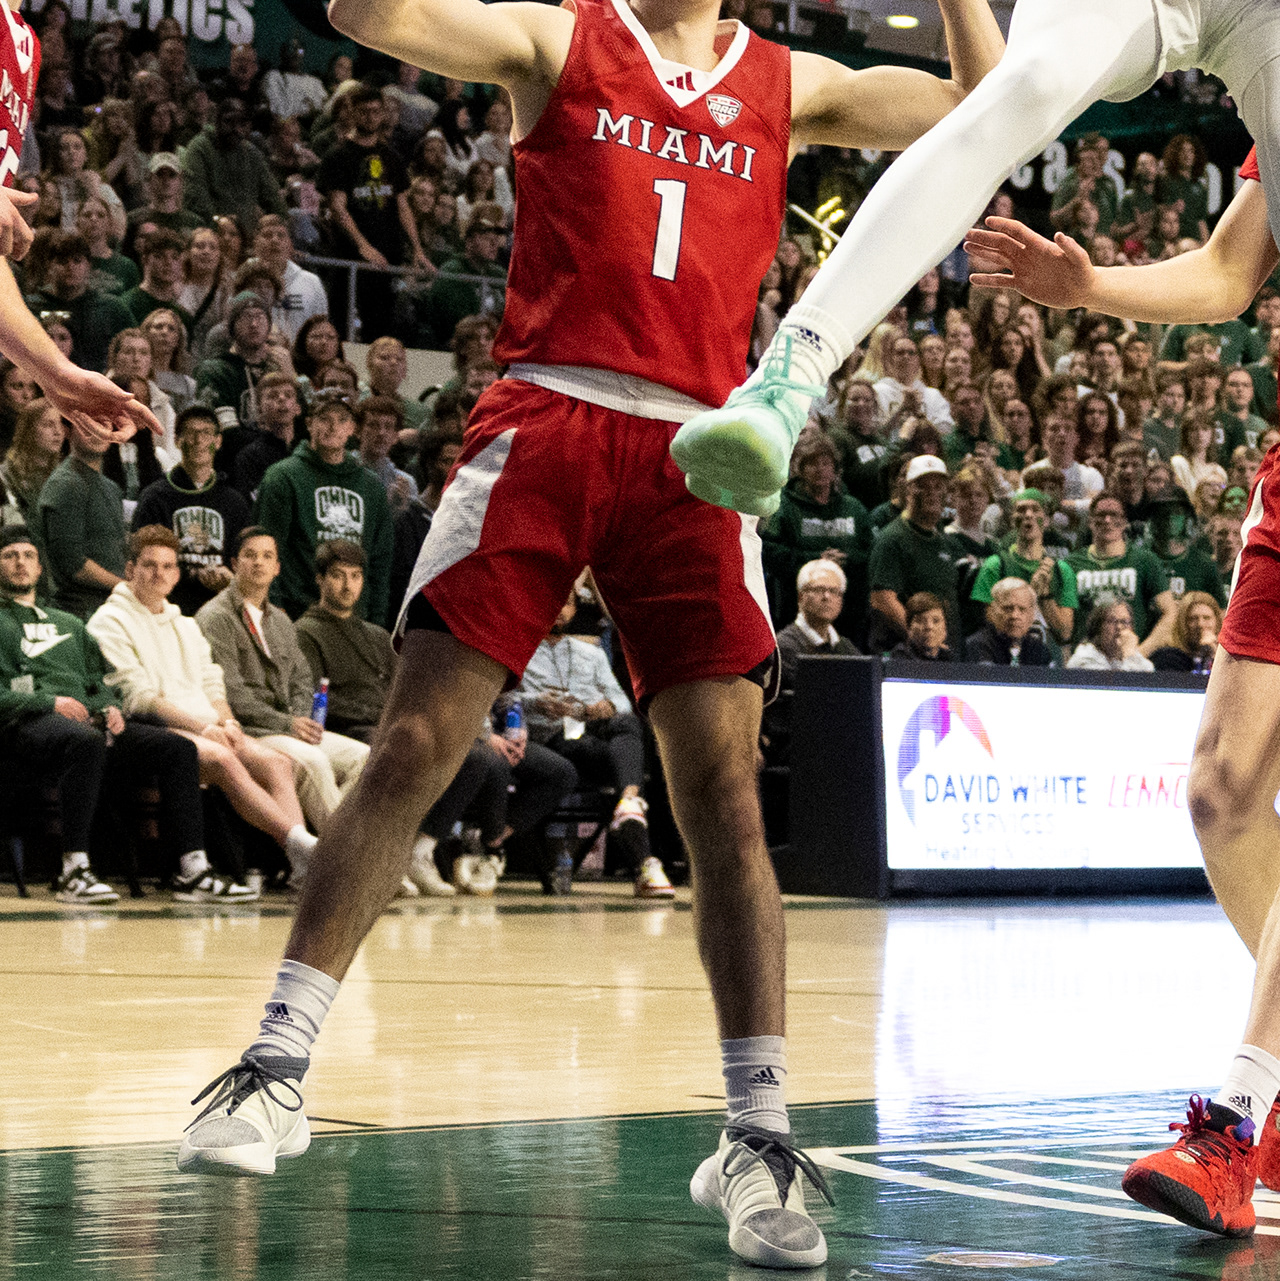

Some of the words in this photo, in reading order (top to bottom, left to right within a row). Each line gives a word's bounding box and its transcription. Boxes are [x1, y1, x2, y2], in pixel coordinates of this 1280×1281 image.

[592, 108, 757, 182] MIAMI
[652, 178, 687, 281] 1
[924, 774, 1001, 803] DAVID
[1009, 775, 1087, 804] WHITE
[962, 812, 1055, 835] SERVICES
[926, 841, 997, 865] Heating
[750, 1077, 781, 1088] adidas
